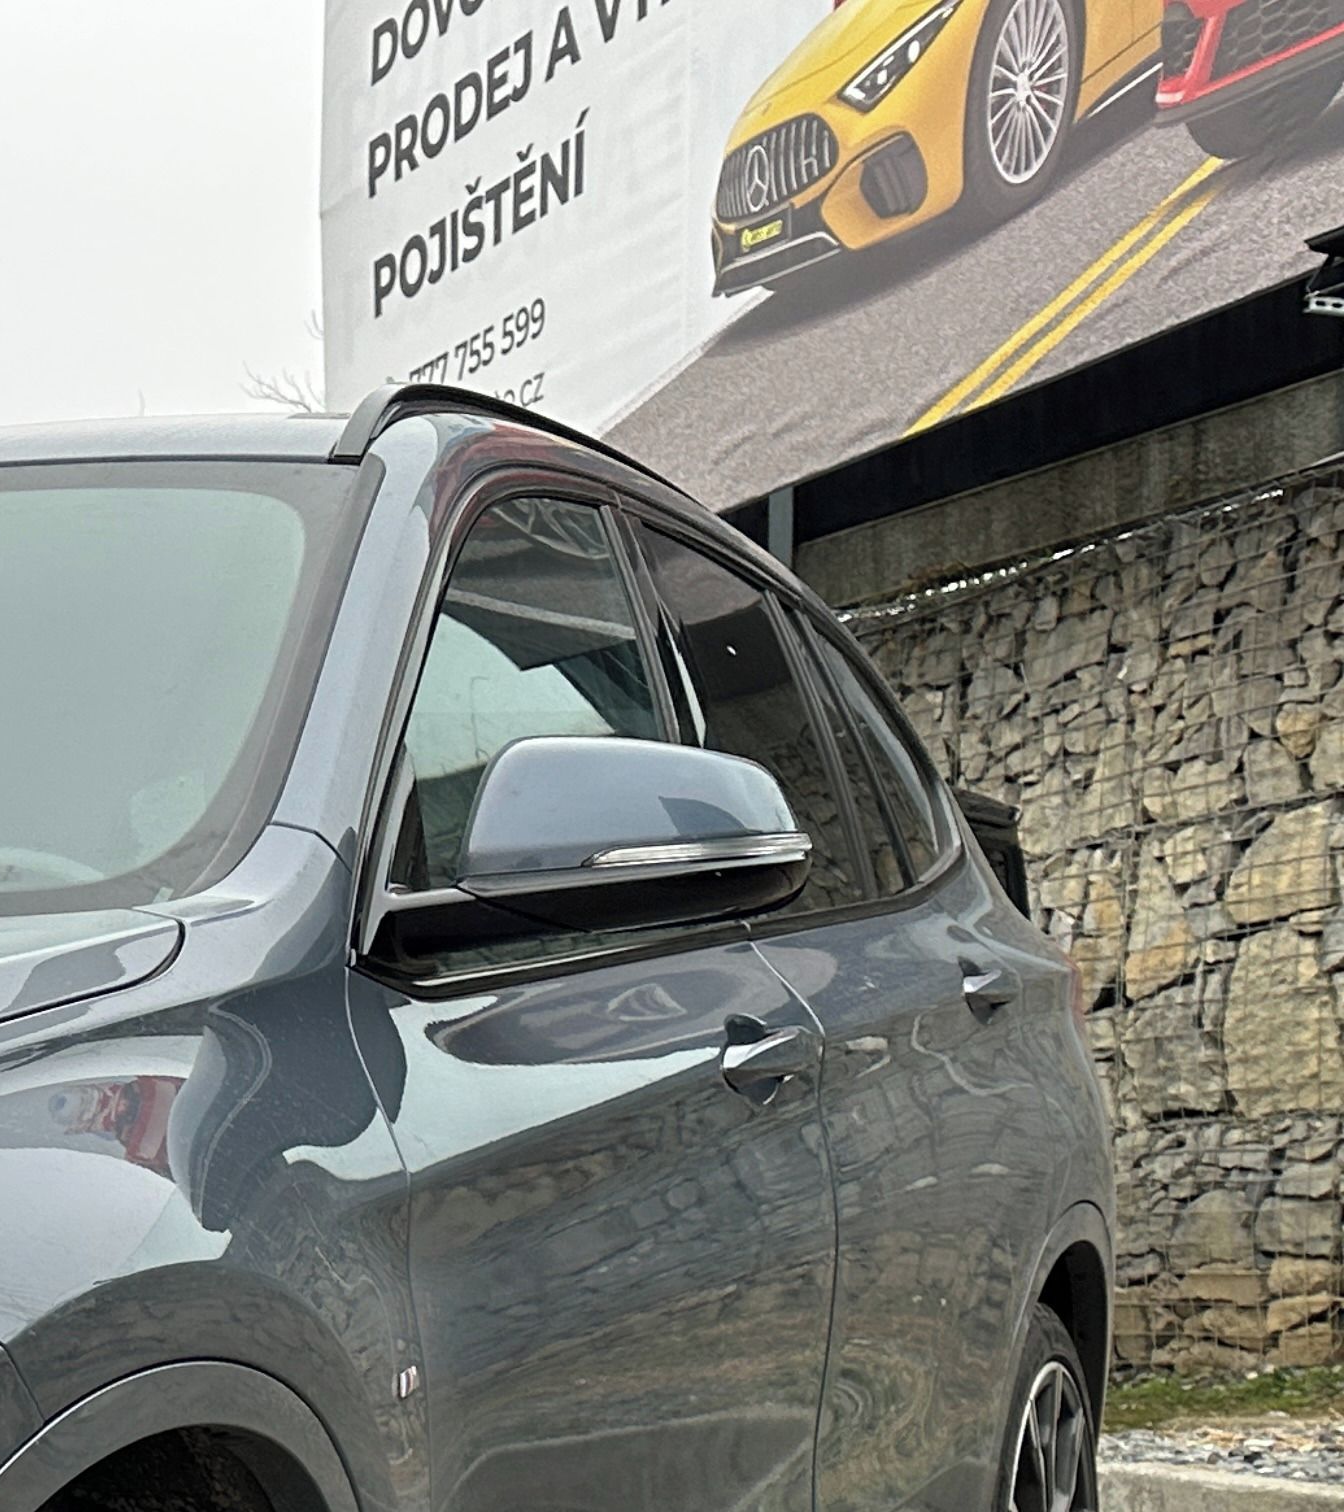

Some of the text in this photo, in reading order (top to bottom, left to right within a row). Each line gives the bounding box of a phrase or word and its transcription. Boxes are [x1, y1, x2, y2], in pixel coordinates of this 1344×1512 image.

[368, 5, 581, 199] PRODEJ A
[371, 0, 485, 86] DOV
[374, 106, 591, 319] POJIŠTĚNÍ
[454, 325, 495, 381] 755
[500, 297, 545, 355] 599
